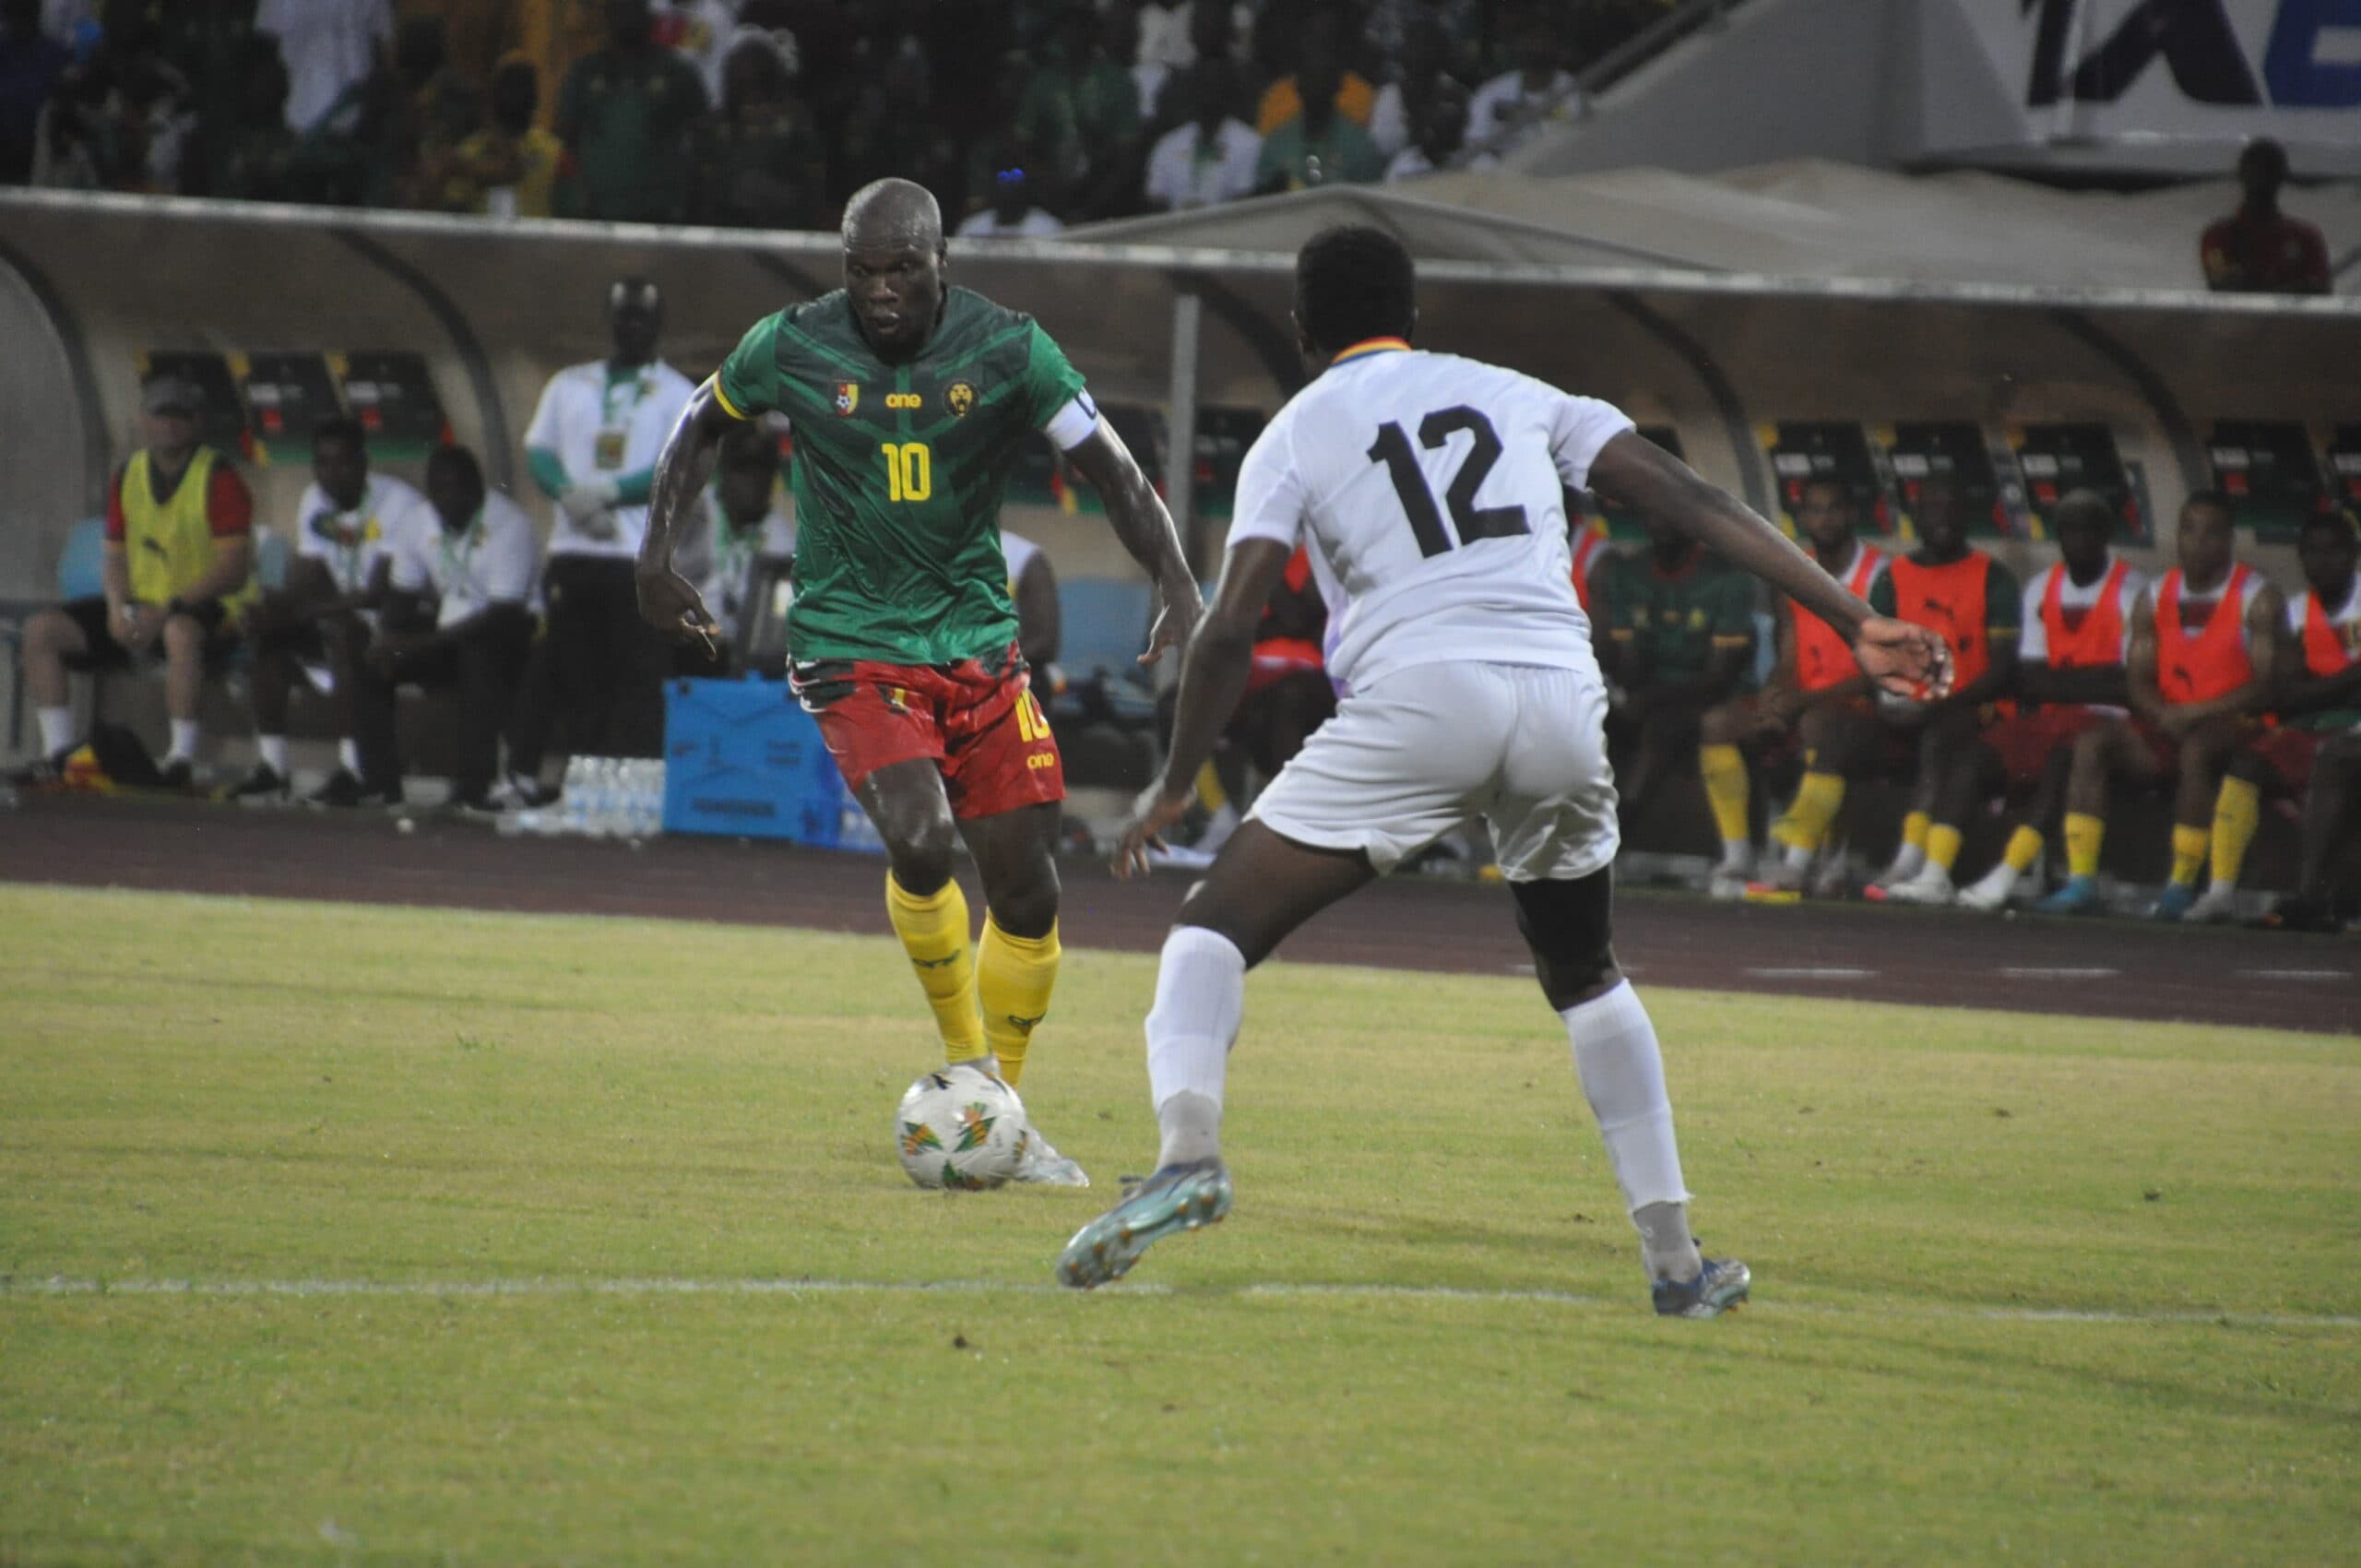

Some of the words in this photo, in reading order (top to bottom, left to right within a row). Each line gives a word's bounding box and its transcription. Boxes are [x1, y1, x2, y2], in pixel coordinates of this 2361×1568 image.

[885, 393, 922, 409] one
[882, 443, 931, 502] 10
[1366, 403, 1533, 559] 12
[1026, 753, 1054, 769] one
